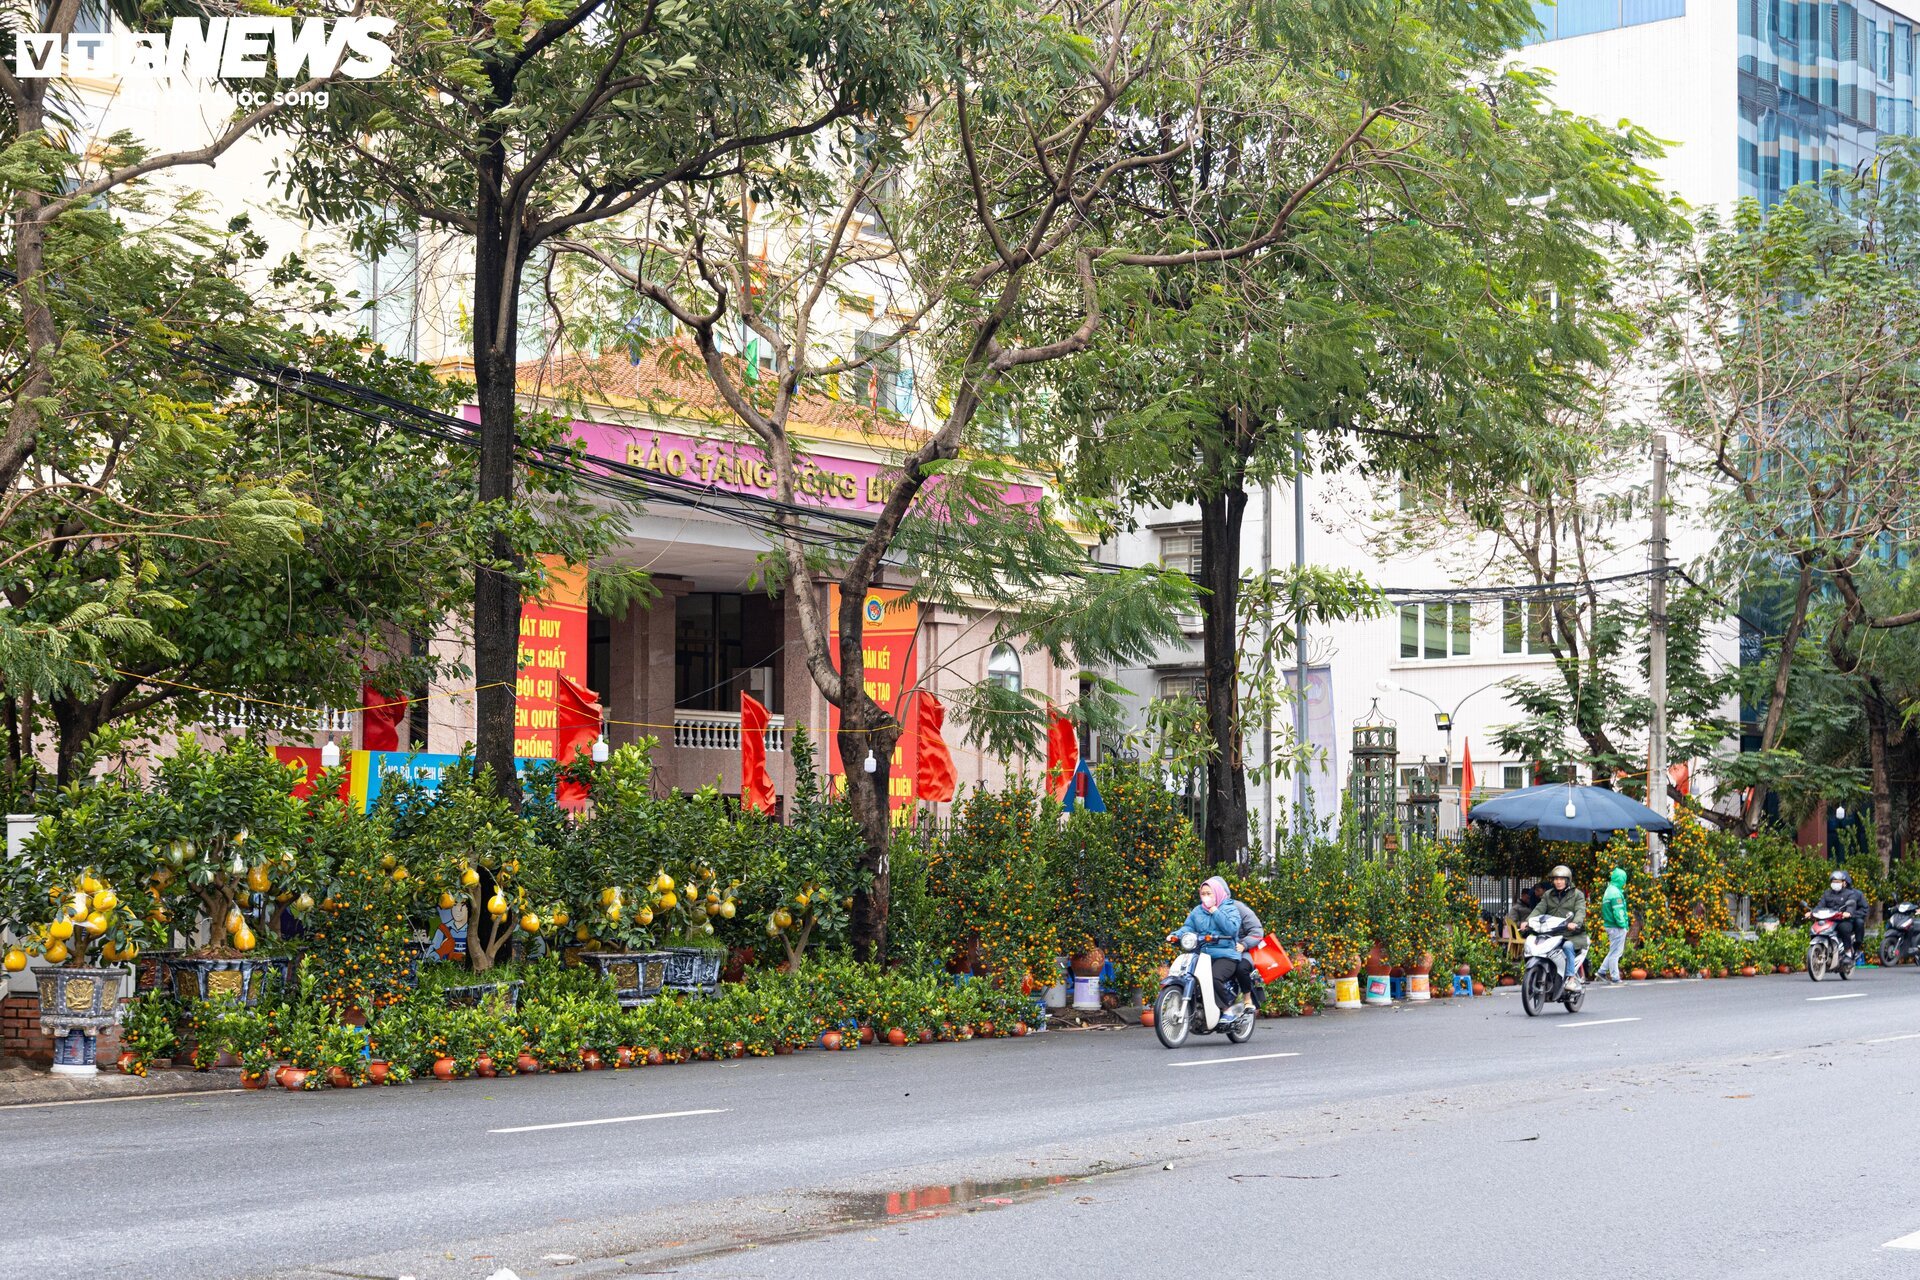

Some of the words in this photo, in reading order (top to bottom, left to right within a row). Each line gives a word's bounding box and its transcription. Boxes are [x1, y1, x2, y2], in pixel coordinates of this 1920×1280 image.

[626, 435, 687, 477] BẢO
[695, 446, 774, 489] TÀNG
[791, 460, 858, 500] ÔNG
[539, 619, 561, 638] HUY
[537, 645, 566, 669] CHẤT
[863, 646, 877, 669] OÀN
[877, 645, 890, 670] KẾT
[537, 679, 553, 702] CỤ
[877, 682, 891, 705] TẠO
[531, 706, 557, 730] QUYẾ
[514, 733, 553, 758] CHỐNG
